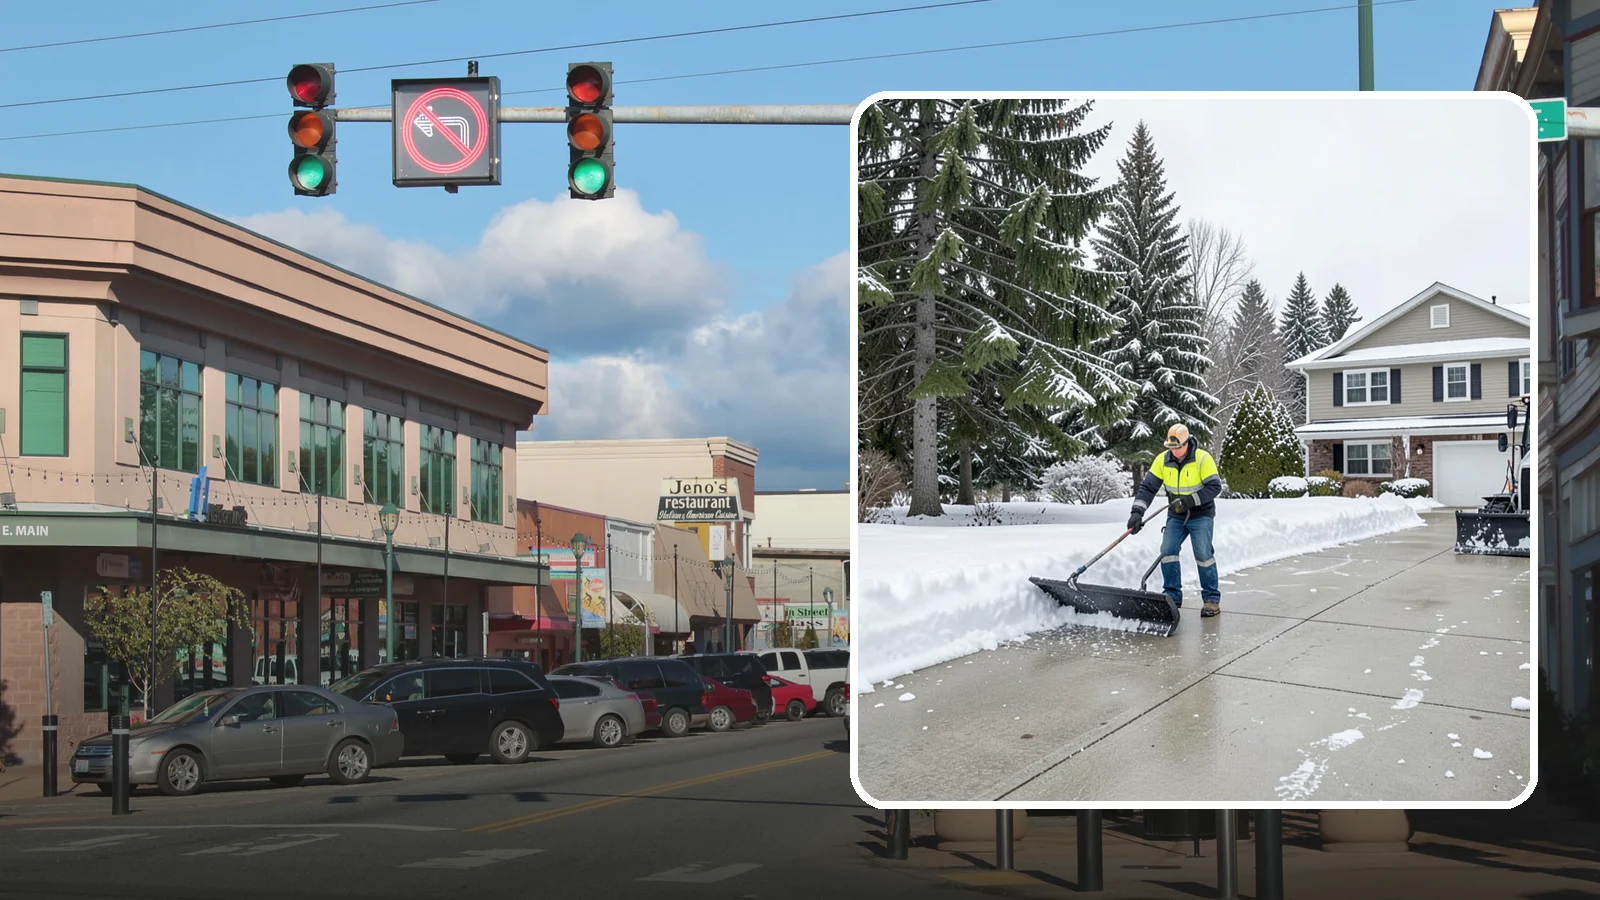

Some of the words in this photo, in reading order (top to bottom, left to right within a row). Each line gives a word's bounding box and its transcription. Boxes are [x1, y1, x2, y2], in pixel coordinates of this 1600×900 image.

[669, 480, 728, 495] Jeno's
[665, 496, 731, 509] restaurant
[658, 509, 682, 519] Italian
[686, 509, 714, 519] American
[715, 509, 738, 519] Cuisine
[2, 525, 13, 536] E.
[15, 525, 49, 536] MAIN
[797, 607, 829, 617] Street
[790, 619, 824, 627] lass
